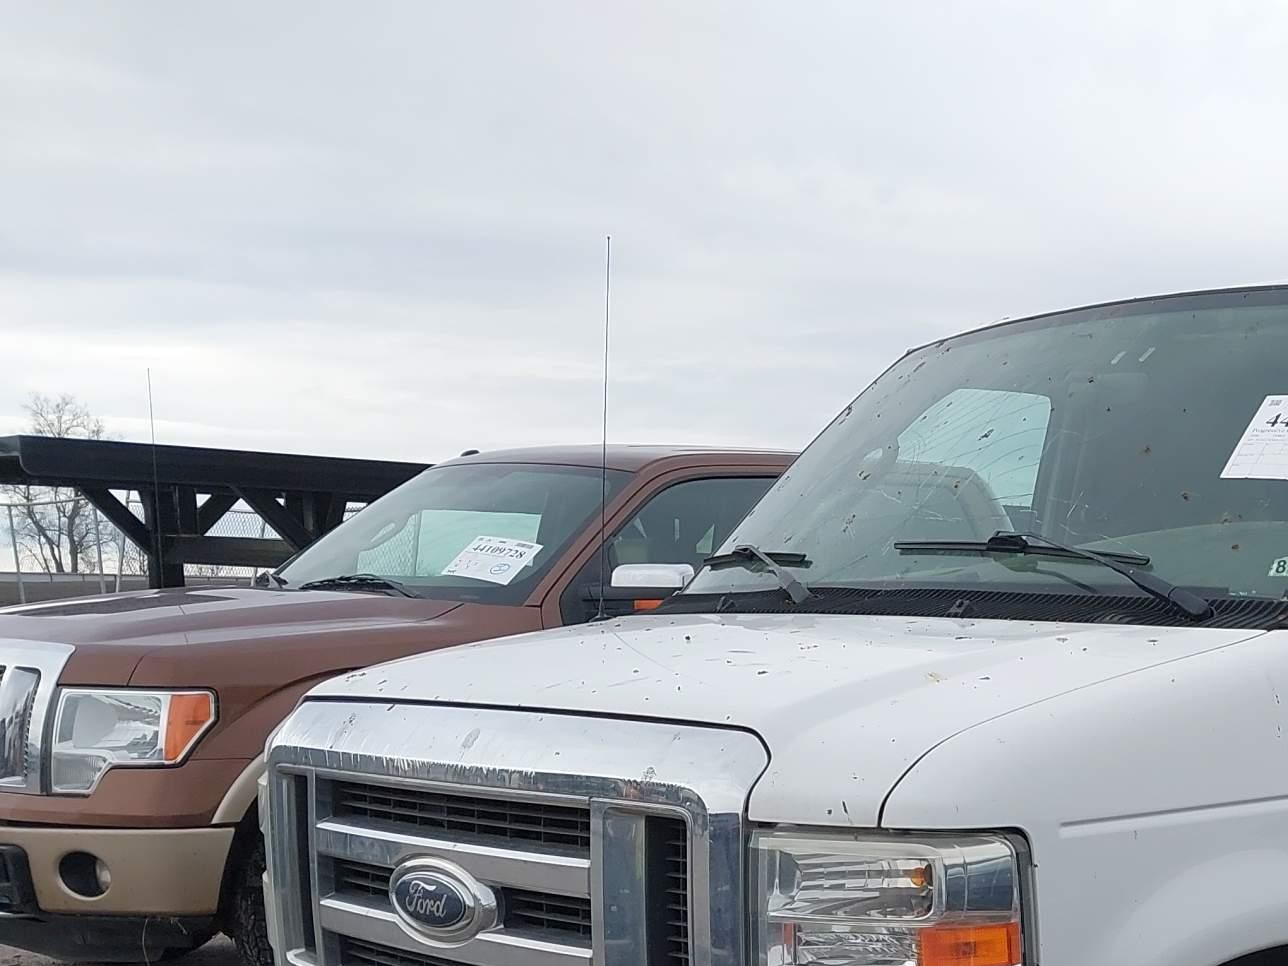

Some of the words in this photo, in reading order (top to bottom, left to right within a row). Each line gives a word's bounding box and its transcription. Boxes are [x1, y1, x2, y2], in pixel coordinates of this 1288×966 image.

[472, 544, 527, 560] 44109728
[1275, 559, 1287, 574] 8
[405, 880, 448, 918] Ford
